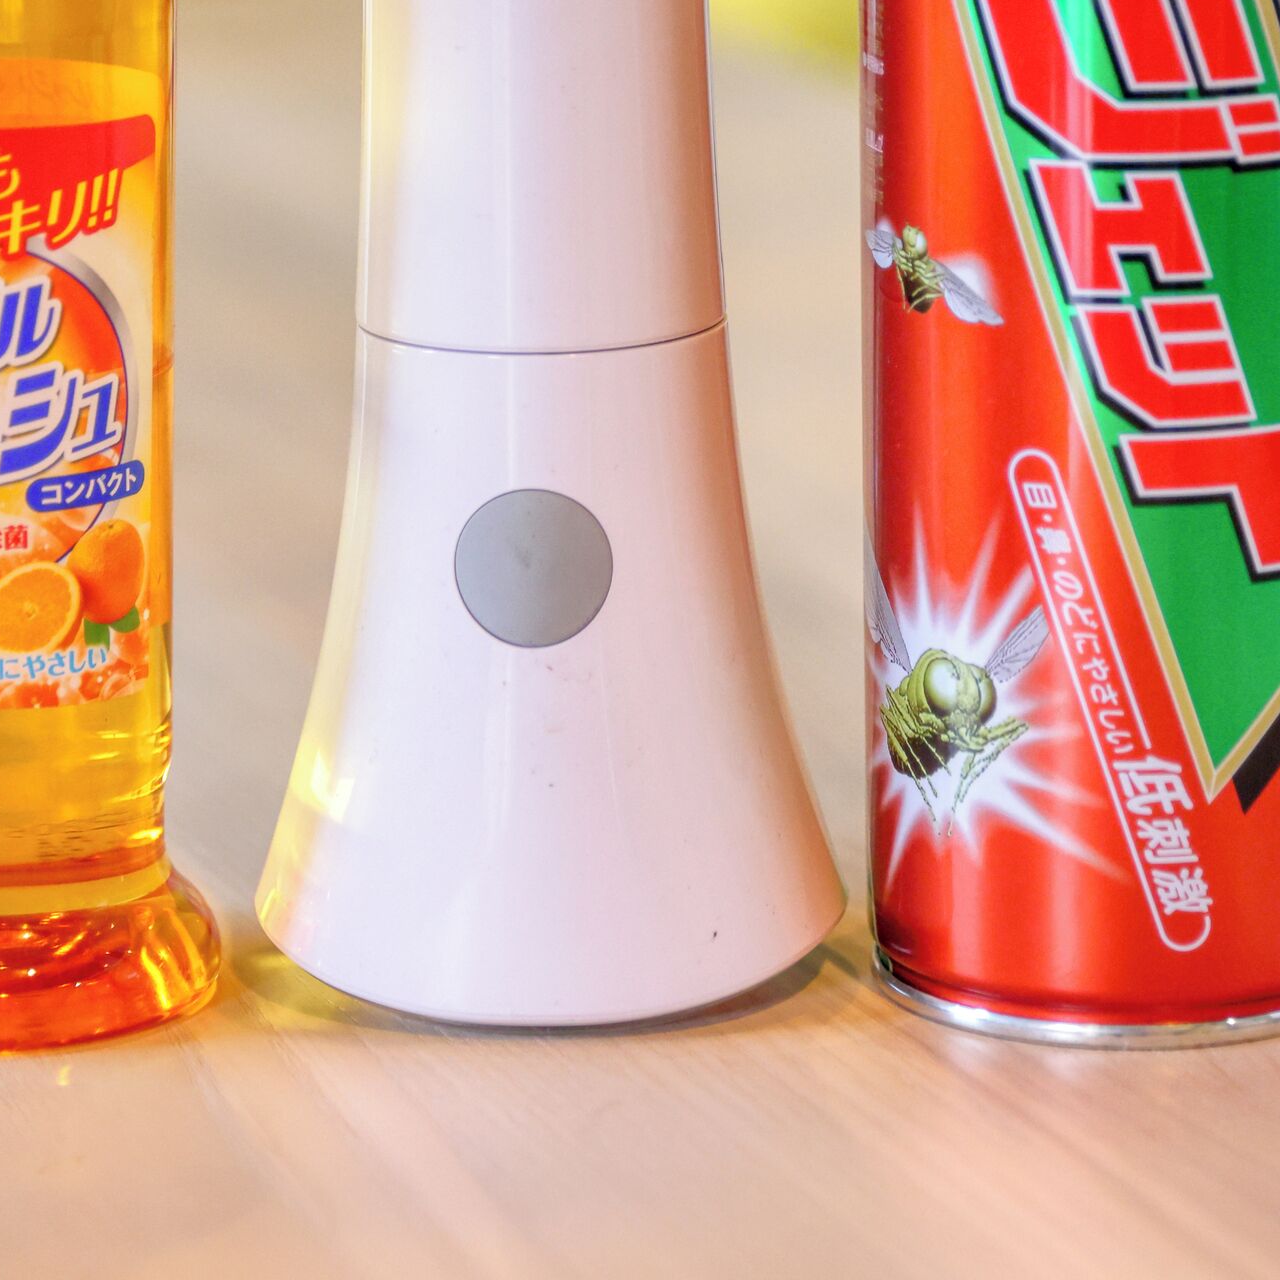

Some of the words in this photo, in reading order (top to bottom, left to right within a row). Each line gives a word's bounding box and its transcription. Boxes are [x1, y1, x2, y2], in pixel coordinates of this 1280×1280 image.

[40, 468, 137, 507] コンパクト
